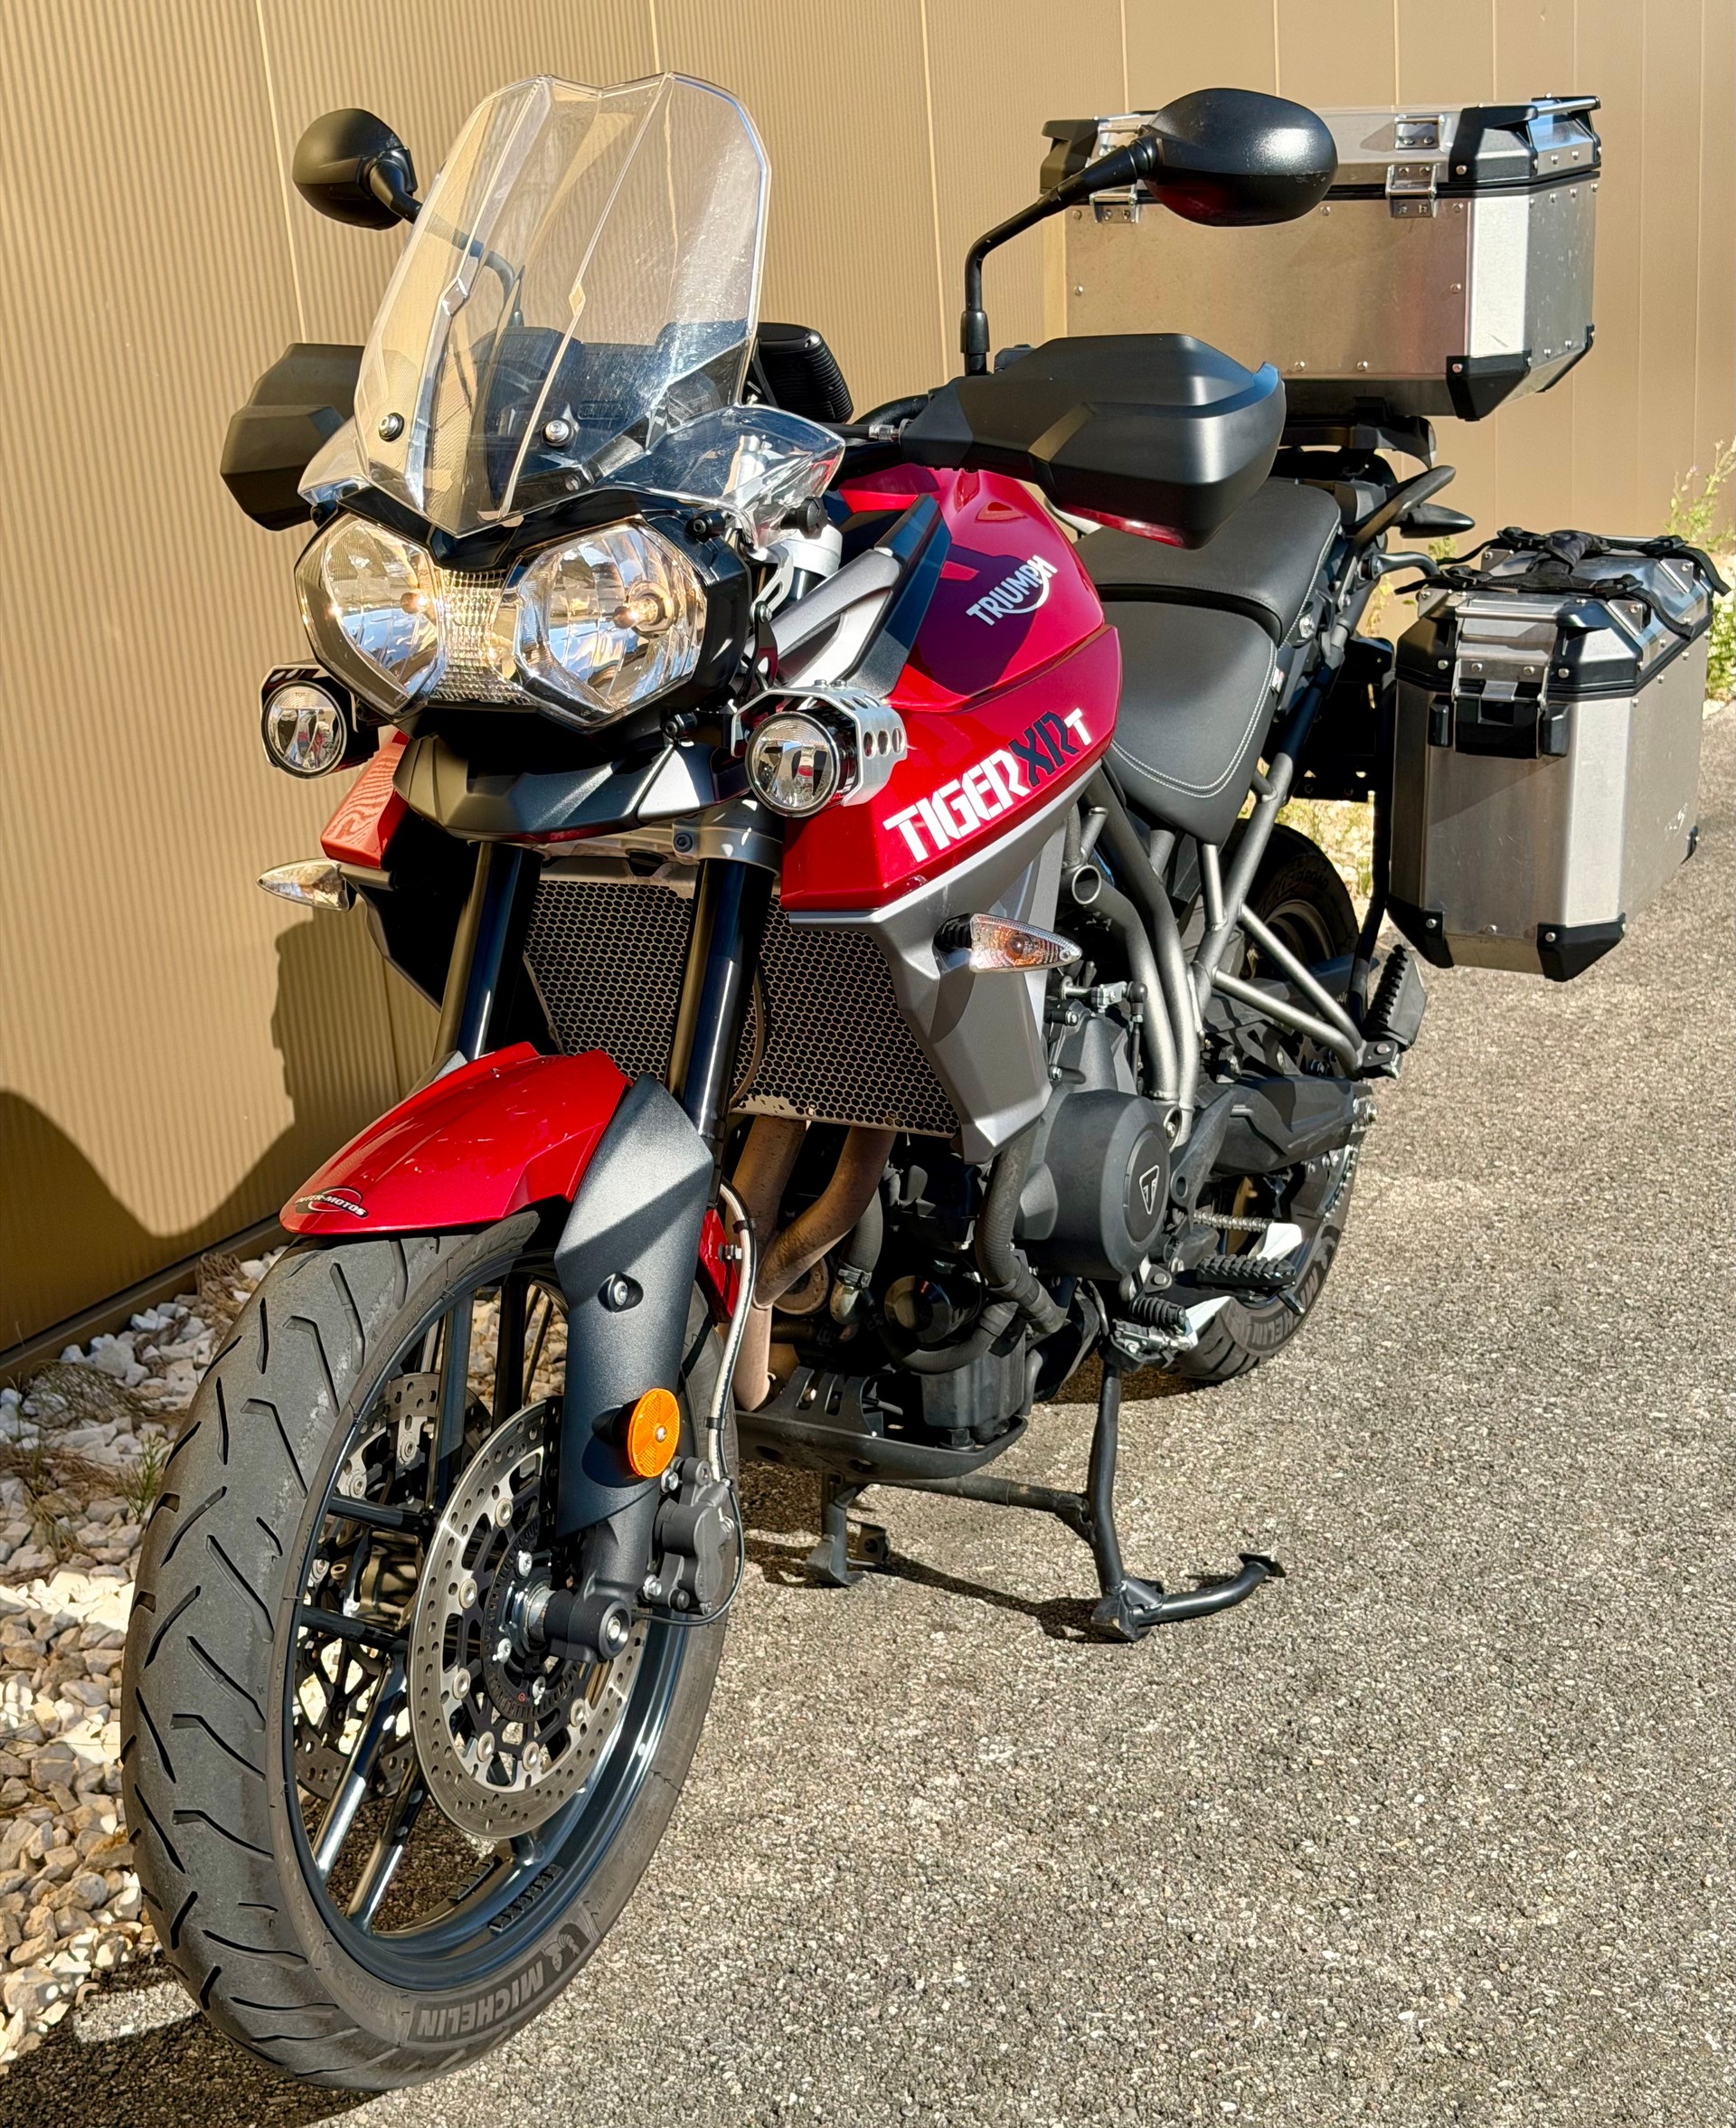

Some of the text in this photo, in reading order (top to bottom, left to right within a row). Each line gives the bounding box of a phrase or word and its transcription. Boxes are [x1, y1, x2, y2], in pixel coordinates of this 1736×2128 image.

[966, 554, 1058, 626] TRIUMPH
[882, 749, 1031, 863] TIGER
[1251, 1266, 1319, 1346] MIHELIN
[419, 1960, 543, 2037] MICHELIN
